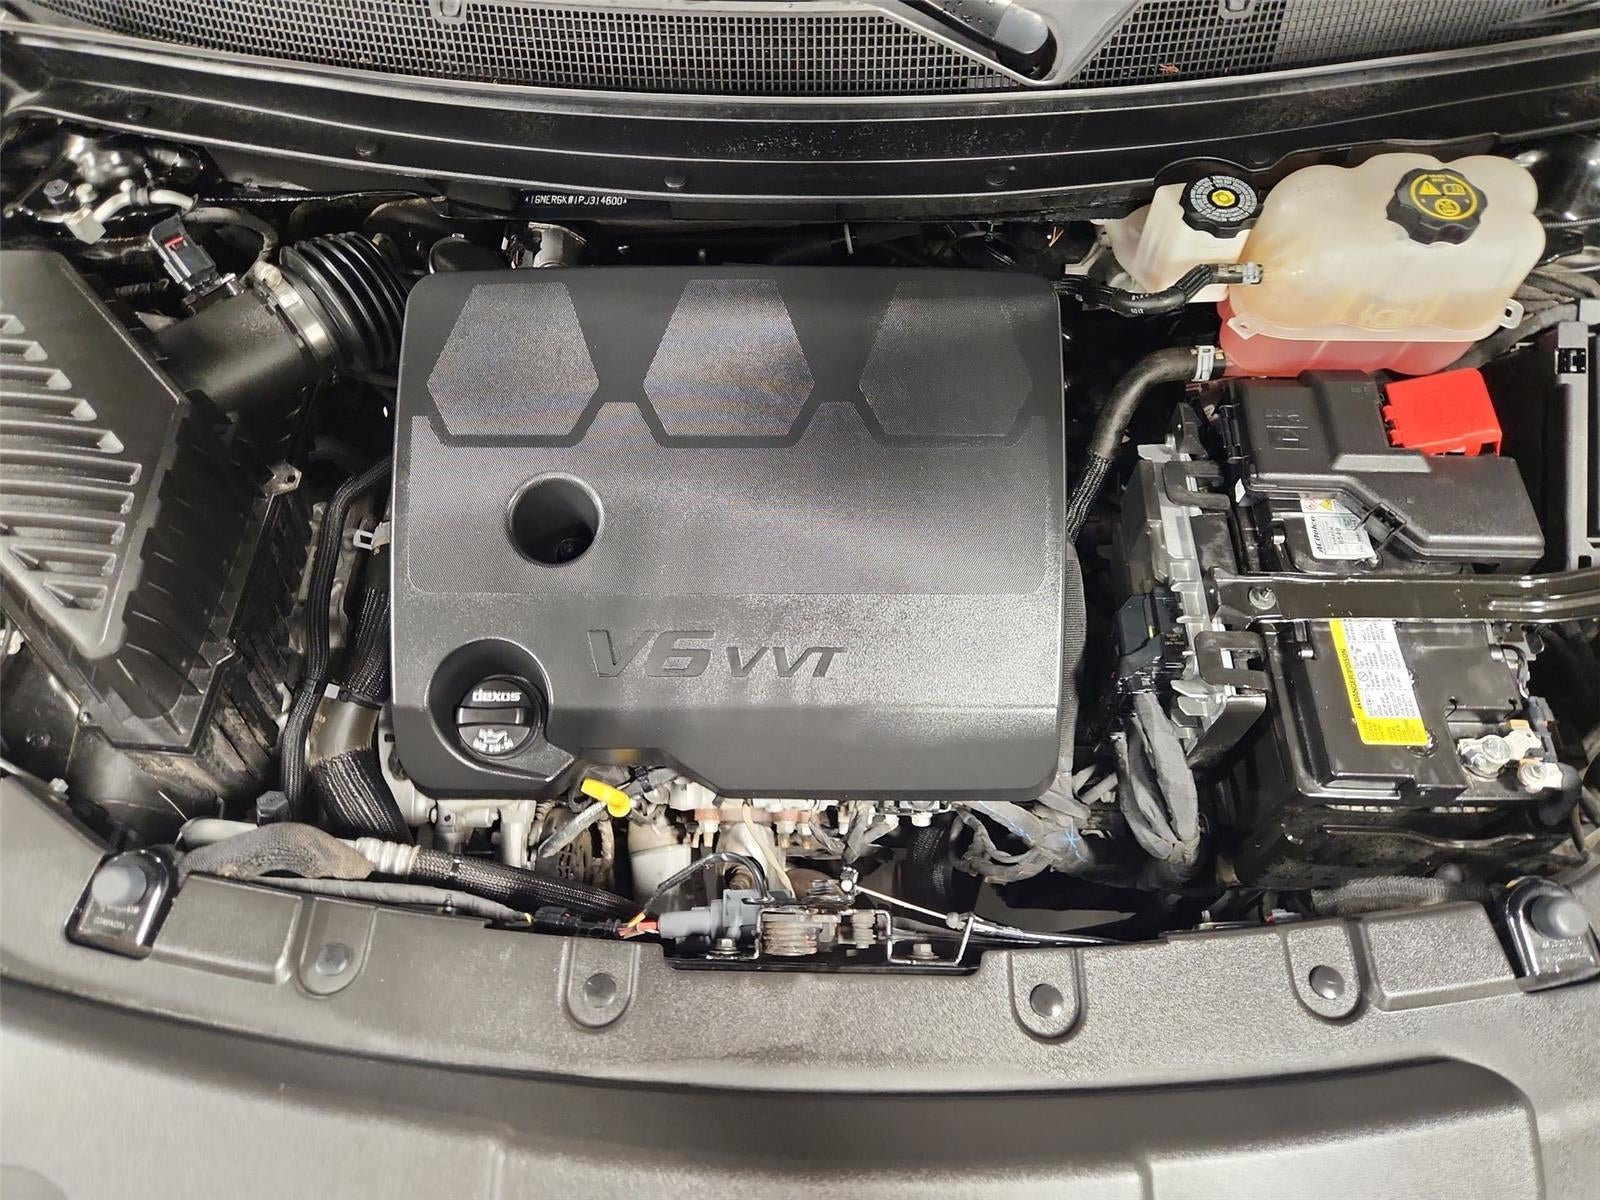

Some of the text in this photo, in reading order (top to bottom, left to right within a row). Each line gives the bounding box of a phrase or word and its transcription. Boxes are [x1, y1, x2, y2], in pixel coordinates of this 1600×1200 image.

[587, 630, 848, 677] V6 VVT
[472, 688, 522, 702] dexos
